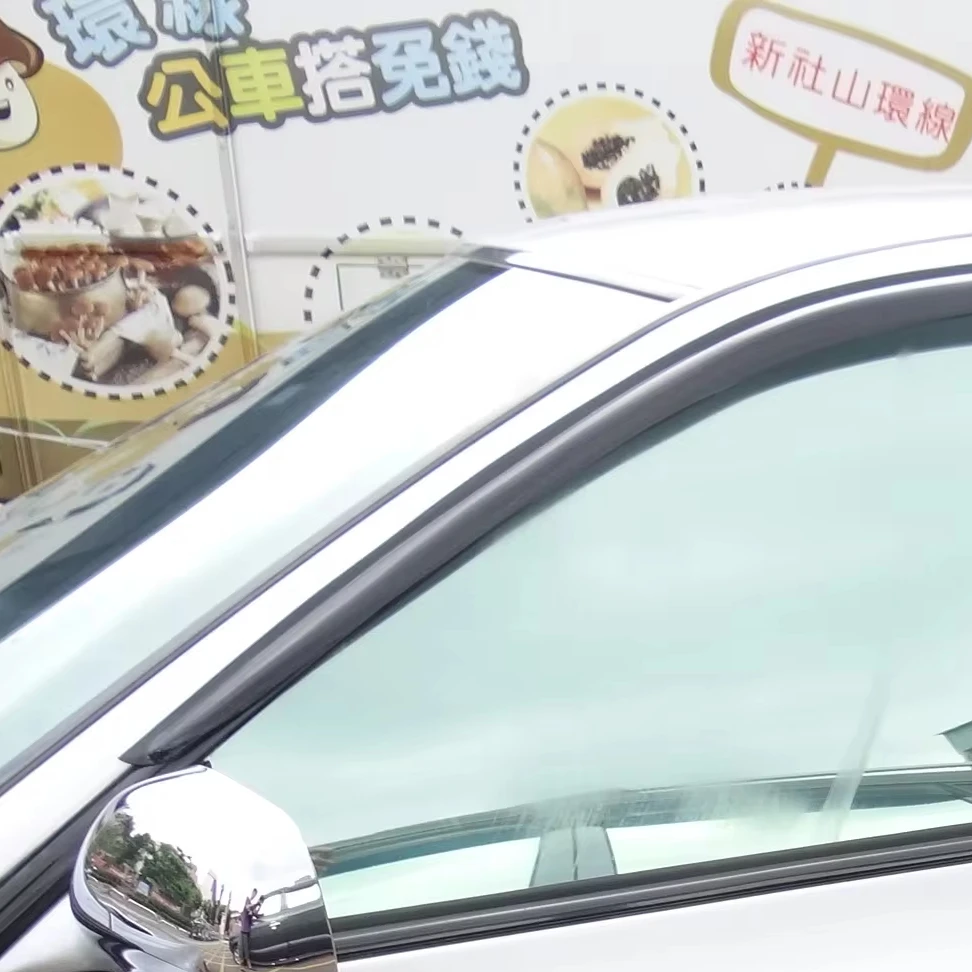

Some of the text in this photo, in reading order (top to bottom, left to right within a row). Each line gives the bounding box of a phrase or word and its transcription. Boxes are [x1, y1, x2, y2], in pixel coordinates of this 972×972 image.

[141, 11, 526, 138] 公車搭免錢
[742, 32, 956, 143] 新社山環線
